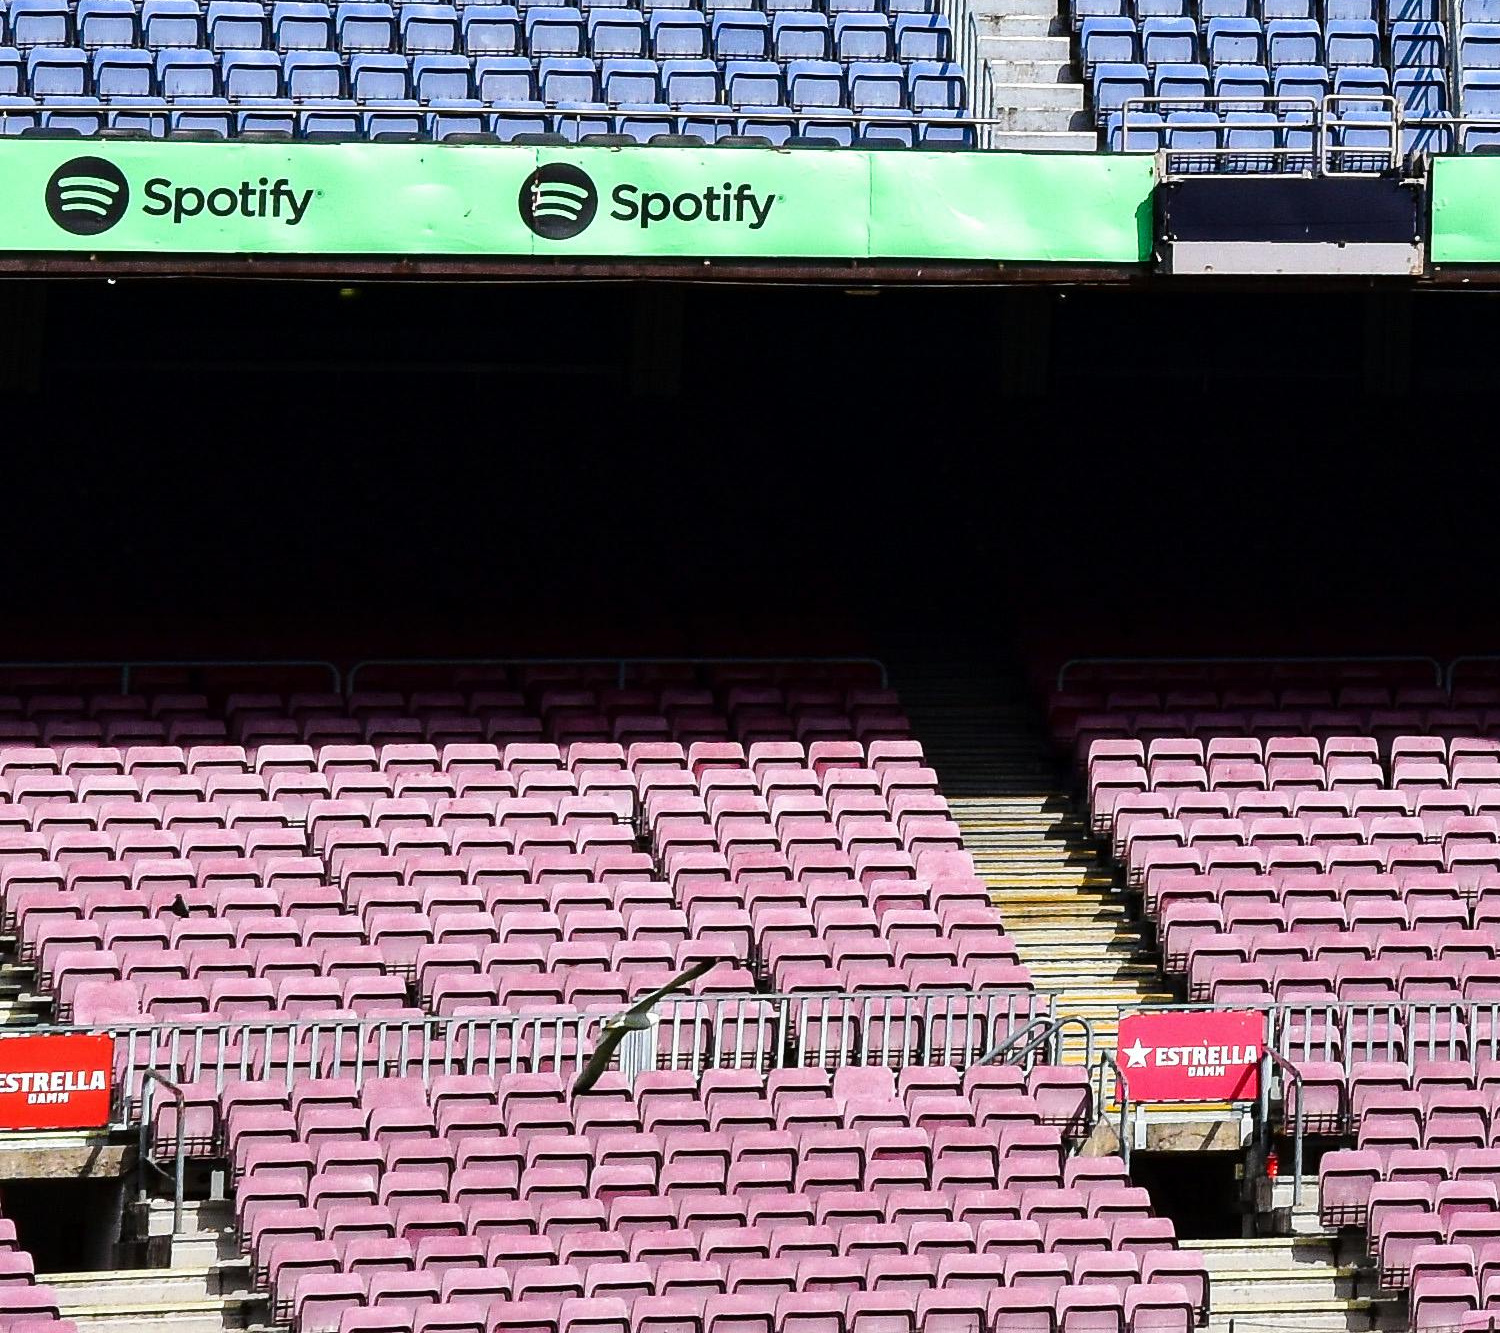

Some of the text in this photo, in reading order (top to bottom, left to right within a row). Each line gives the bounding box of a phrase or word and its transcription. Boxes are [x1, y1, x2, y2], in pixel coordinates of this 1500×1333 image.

[142, 177, 314, 226] Spotify
[609, 182, 776, 229] Spotify
[1155, 1045, 1257, 1067] ESTRELLA
[1187, 1065, 1225, 1077] DAMM
[27, 1090, 69, 1104] DAMM
